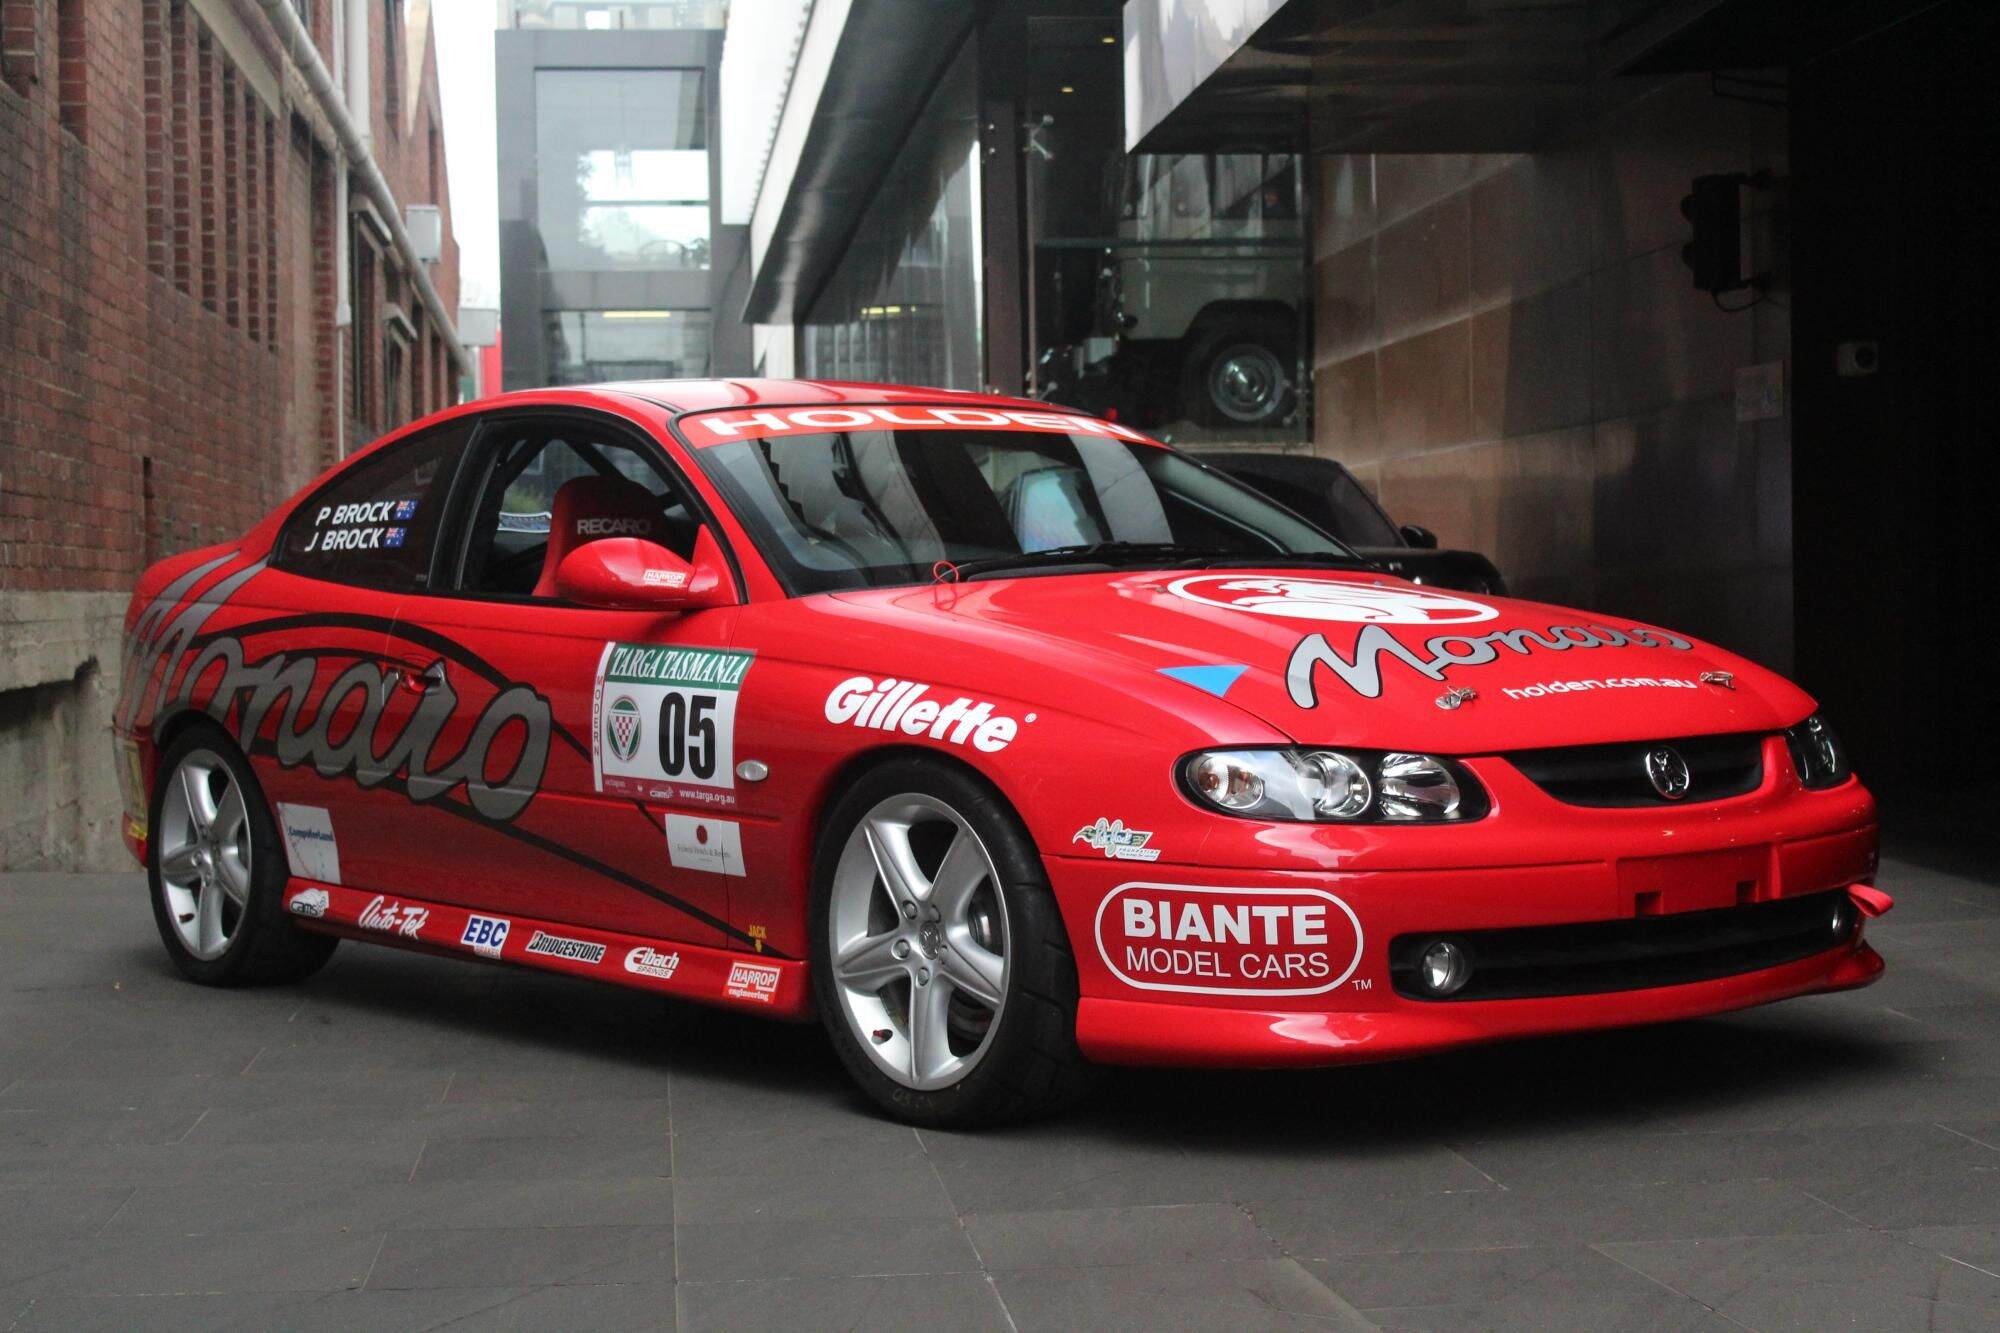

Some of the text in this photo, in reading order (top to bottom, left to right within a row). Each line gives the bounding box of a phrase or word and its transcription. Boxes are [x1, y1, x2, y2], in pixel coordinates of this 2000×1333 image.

[700, 408, 1147, 442] HOLDEN
[315, 501, 396, 526] P BROCK
[577, 518, 650, 535] RECARO
[304, 527, 385, 552] J BROCK
[609, 647, 750, 684] TARGA TASMANIA
[1502, 677, 1698, 699] holden.com.au
[593, 675, 605, 756] MODERN
[824, 676, 1018, 752] Gillette
[658, 692, 718, 780] 05
[679, 788, 736, 805] www.targa.org.au
[358, 895, 429, 941] Auto-Tek
[1123, 898, 1328, 945] BIANTE
[464, 918, 507, 947] EBC
[749, 924, 767, 940] JACK
[530, 933, 605, 962] BRIDGESTONE
[636, 965, 671, 978] SPRINGS
[1126, 946, 1330, 979] MODEL CARS
[733, 969, 776, 987] HARROP
[1352, 979, 1372, 990] TM
[728, 987, 769, 1001] engineering
